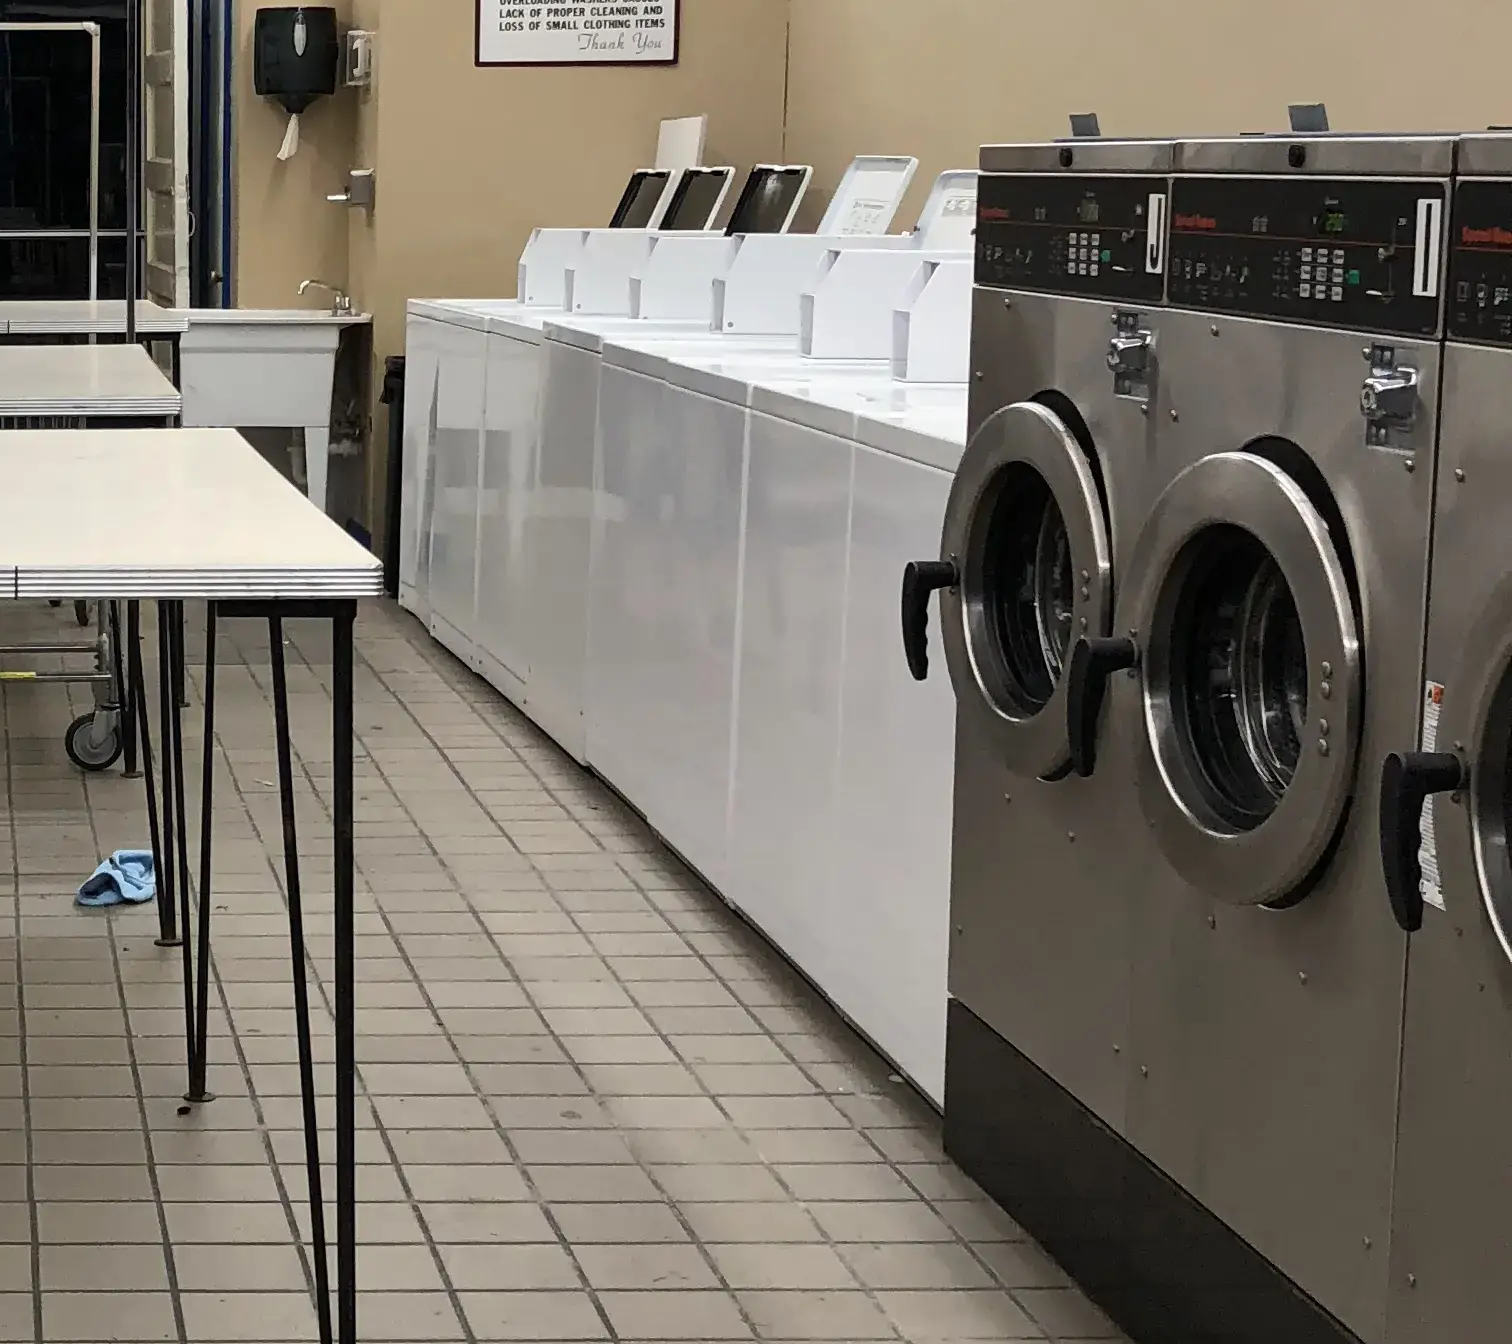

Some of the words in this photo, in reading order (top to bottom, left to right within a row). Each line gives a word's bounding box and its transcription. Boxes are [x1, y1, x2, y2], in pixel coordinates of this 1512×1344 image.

[499, 8, 525, 19] LACK
[529, 8, 542, 18] OF
[546, 7, 586, 18] PROPER
[590, 6, 638, 17] CLEANING
[642, 5, 663, 16] AND
[499, 21, 524, 32] LOSS
[528, 21, 541, 31] OF
[546, 20, 579, 31] SMALL
[583, 19, 631, 30] CLOTHING
[635, 18, 665, 29] ITEMS
[578, 32, 624, 51] Thank
[632, 31, 662, 55] You
